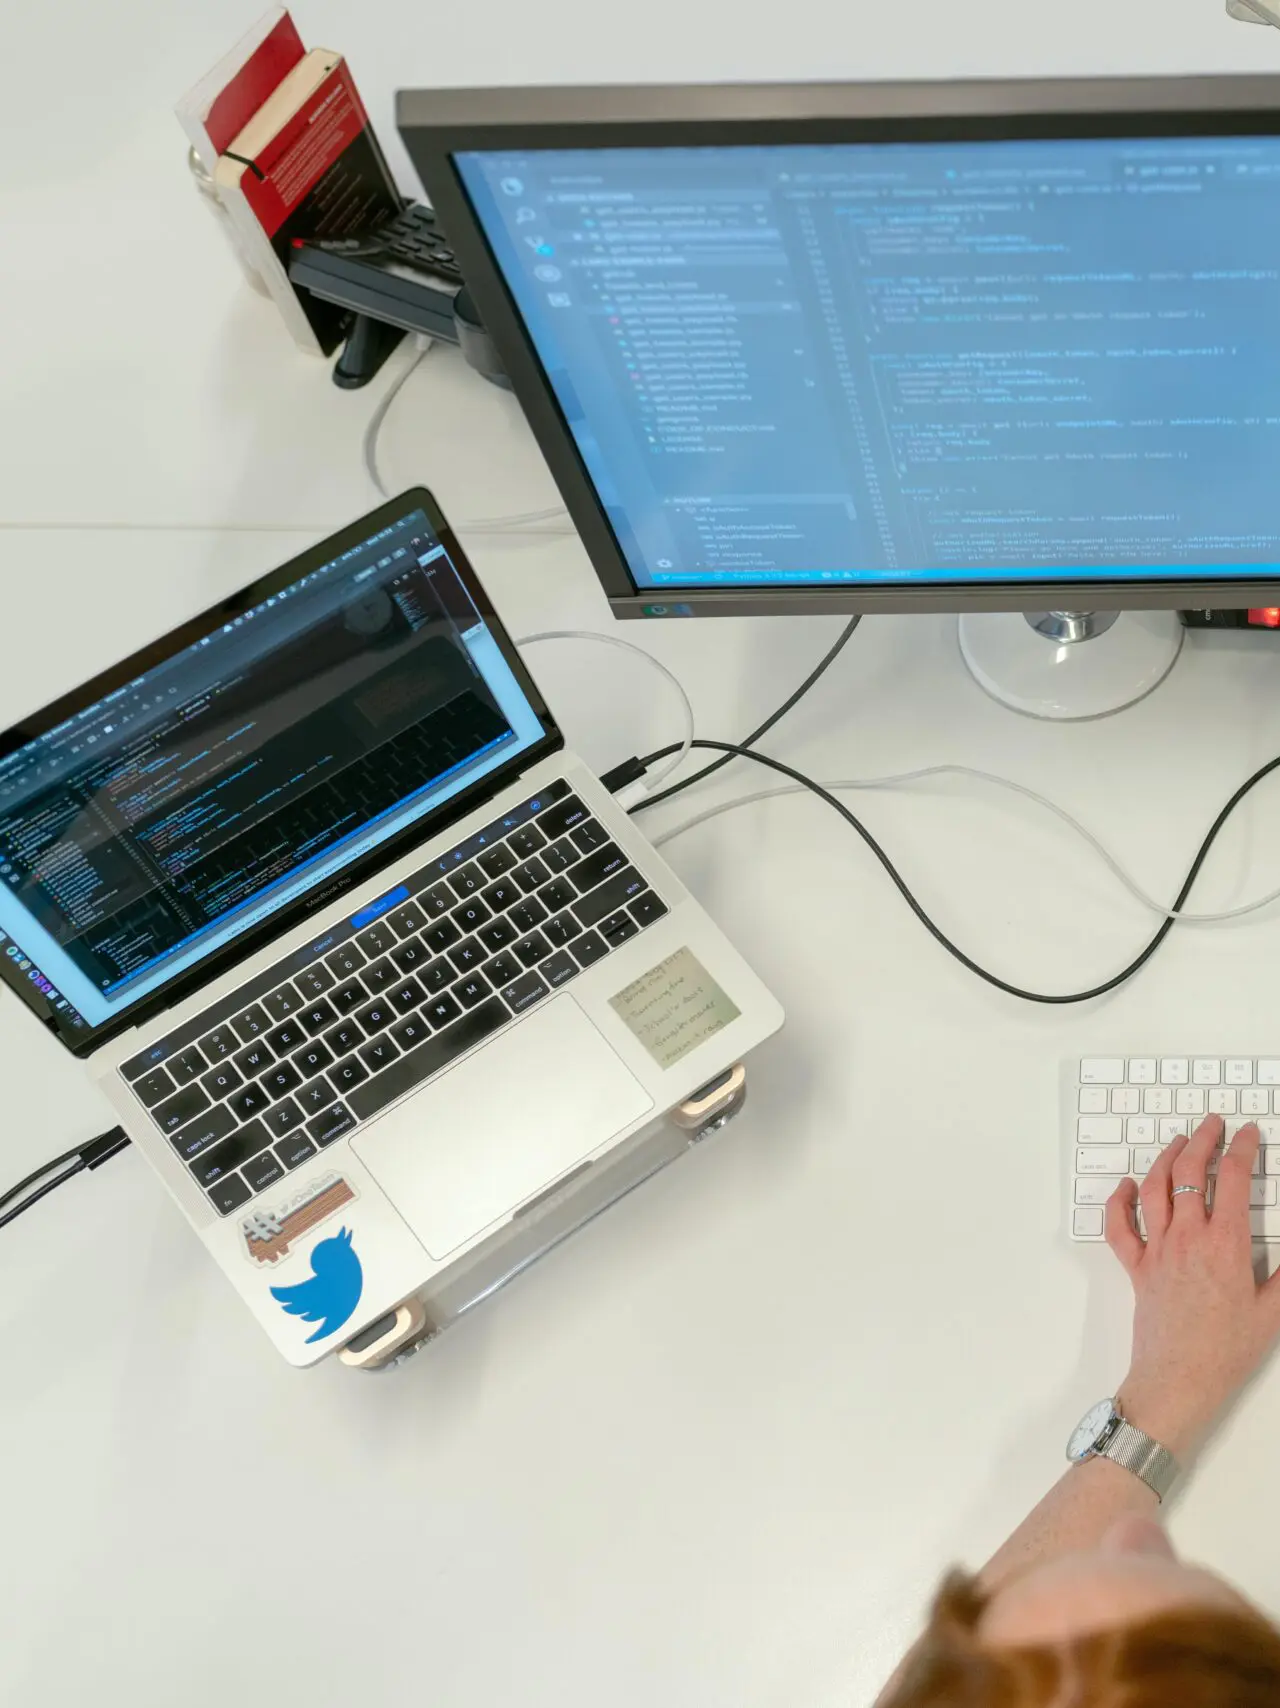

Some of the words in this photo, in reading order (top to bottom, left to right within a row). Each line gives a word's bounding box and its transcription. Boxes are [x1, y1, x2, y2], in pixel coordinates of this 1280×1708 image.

[566, 812, 582, 824] delete
[604, 859, 621, 872] return
[466, 879, 475, 888] 0
[627, 883, 640, 894] shift
[305, 883, 339, 909] MacBook
[337, 875, 352, 888] Pro
[495, 890, 504, 899] P
[435, 899, 445, 908] 9
[405, 919, 415, 929] 8
[437, 931, 445, 939] I
[492, 931, 503, 939] L
[314, 937, 332, 952] Cancel
[375, 939, 382, 949] 7
[405, 949, 416, 959] U
[462, 949, 473, 960] K
[344, 960, 353, 969] 6
[374, 970, 384, 979] Y
[435, 970, 442, 980] J
[553, 969, 571, 982] option
[312, 980, 322, 990] 5
[466, 984, 478, 995] M
[343, 991, 352, 1000] T
[401, 990, 412, 1001] H
[516, 987, 543, 1007] command
[283, 1001, 291, 1010] 4
[435, 1005, 447, 1015] N
[312, 1012, 323, 1022] R
[370, 1011, 381, 1021] G
[249, 1022, 259, 1032] 3
[405, 1026, 415, 1036] B
[280, 1033, 291, 1043] E
[339, 1032, 348, 1042] F
[218, 1043, 228, 1053] 2
[373, 1047, 383, 1056] V
[247, 1053, 259, 1064] W
[307, 1054, 318, 1064] D
[186, 1065, 194, 1073] 1
[342, 1069, 353, 1078] C
[216, 1076, 227, 1086] Q
[276, 1074, 286, 1085] S
[310, 1089, 321, 1101] X
[245, 1097, 255, 1107] A
[278, 1111, 289, 1122] Z
[168, 1118, 179, 1126] tab
[322, 1118, 351, 1139] command
[187, 1139, 203, 1153] caps
[203, 1132, 215, 1143] lock
[291, 1147, 310, 1161] option
[206, 1168, 220, 1179] shift
[257, 1168, 278, 1184] control
